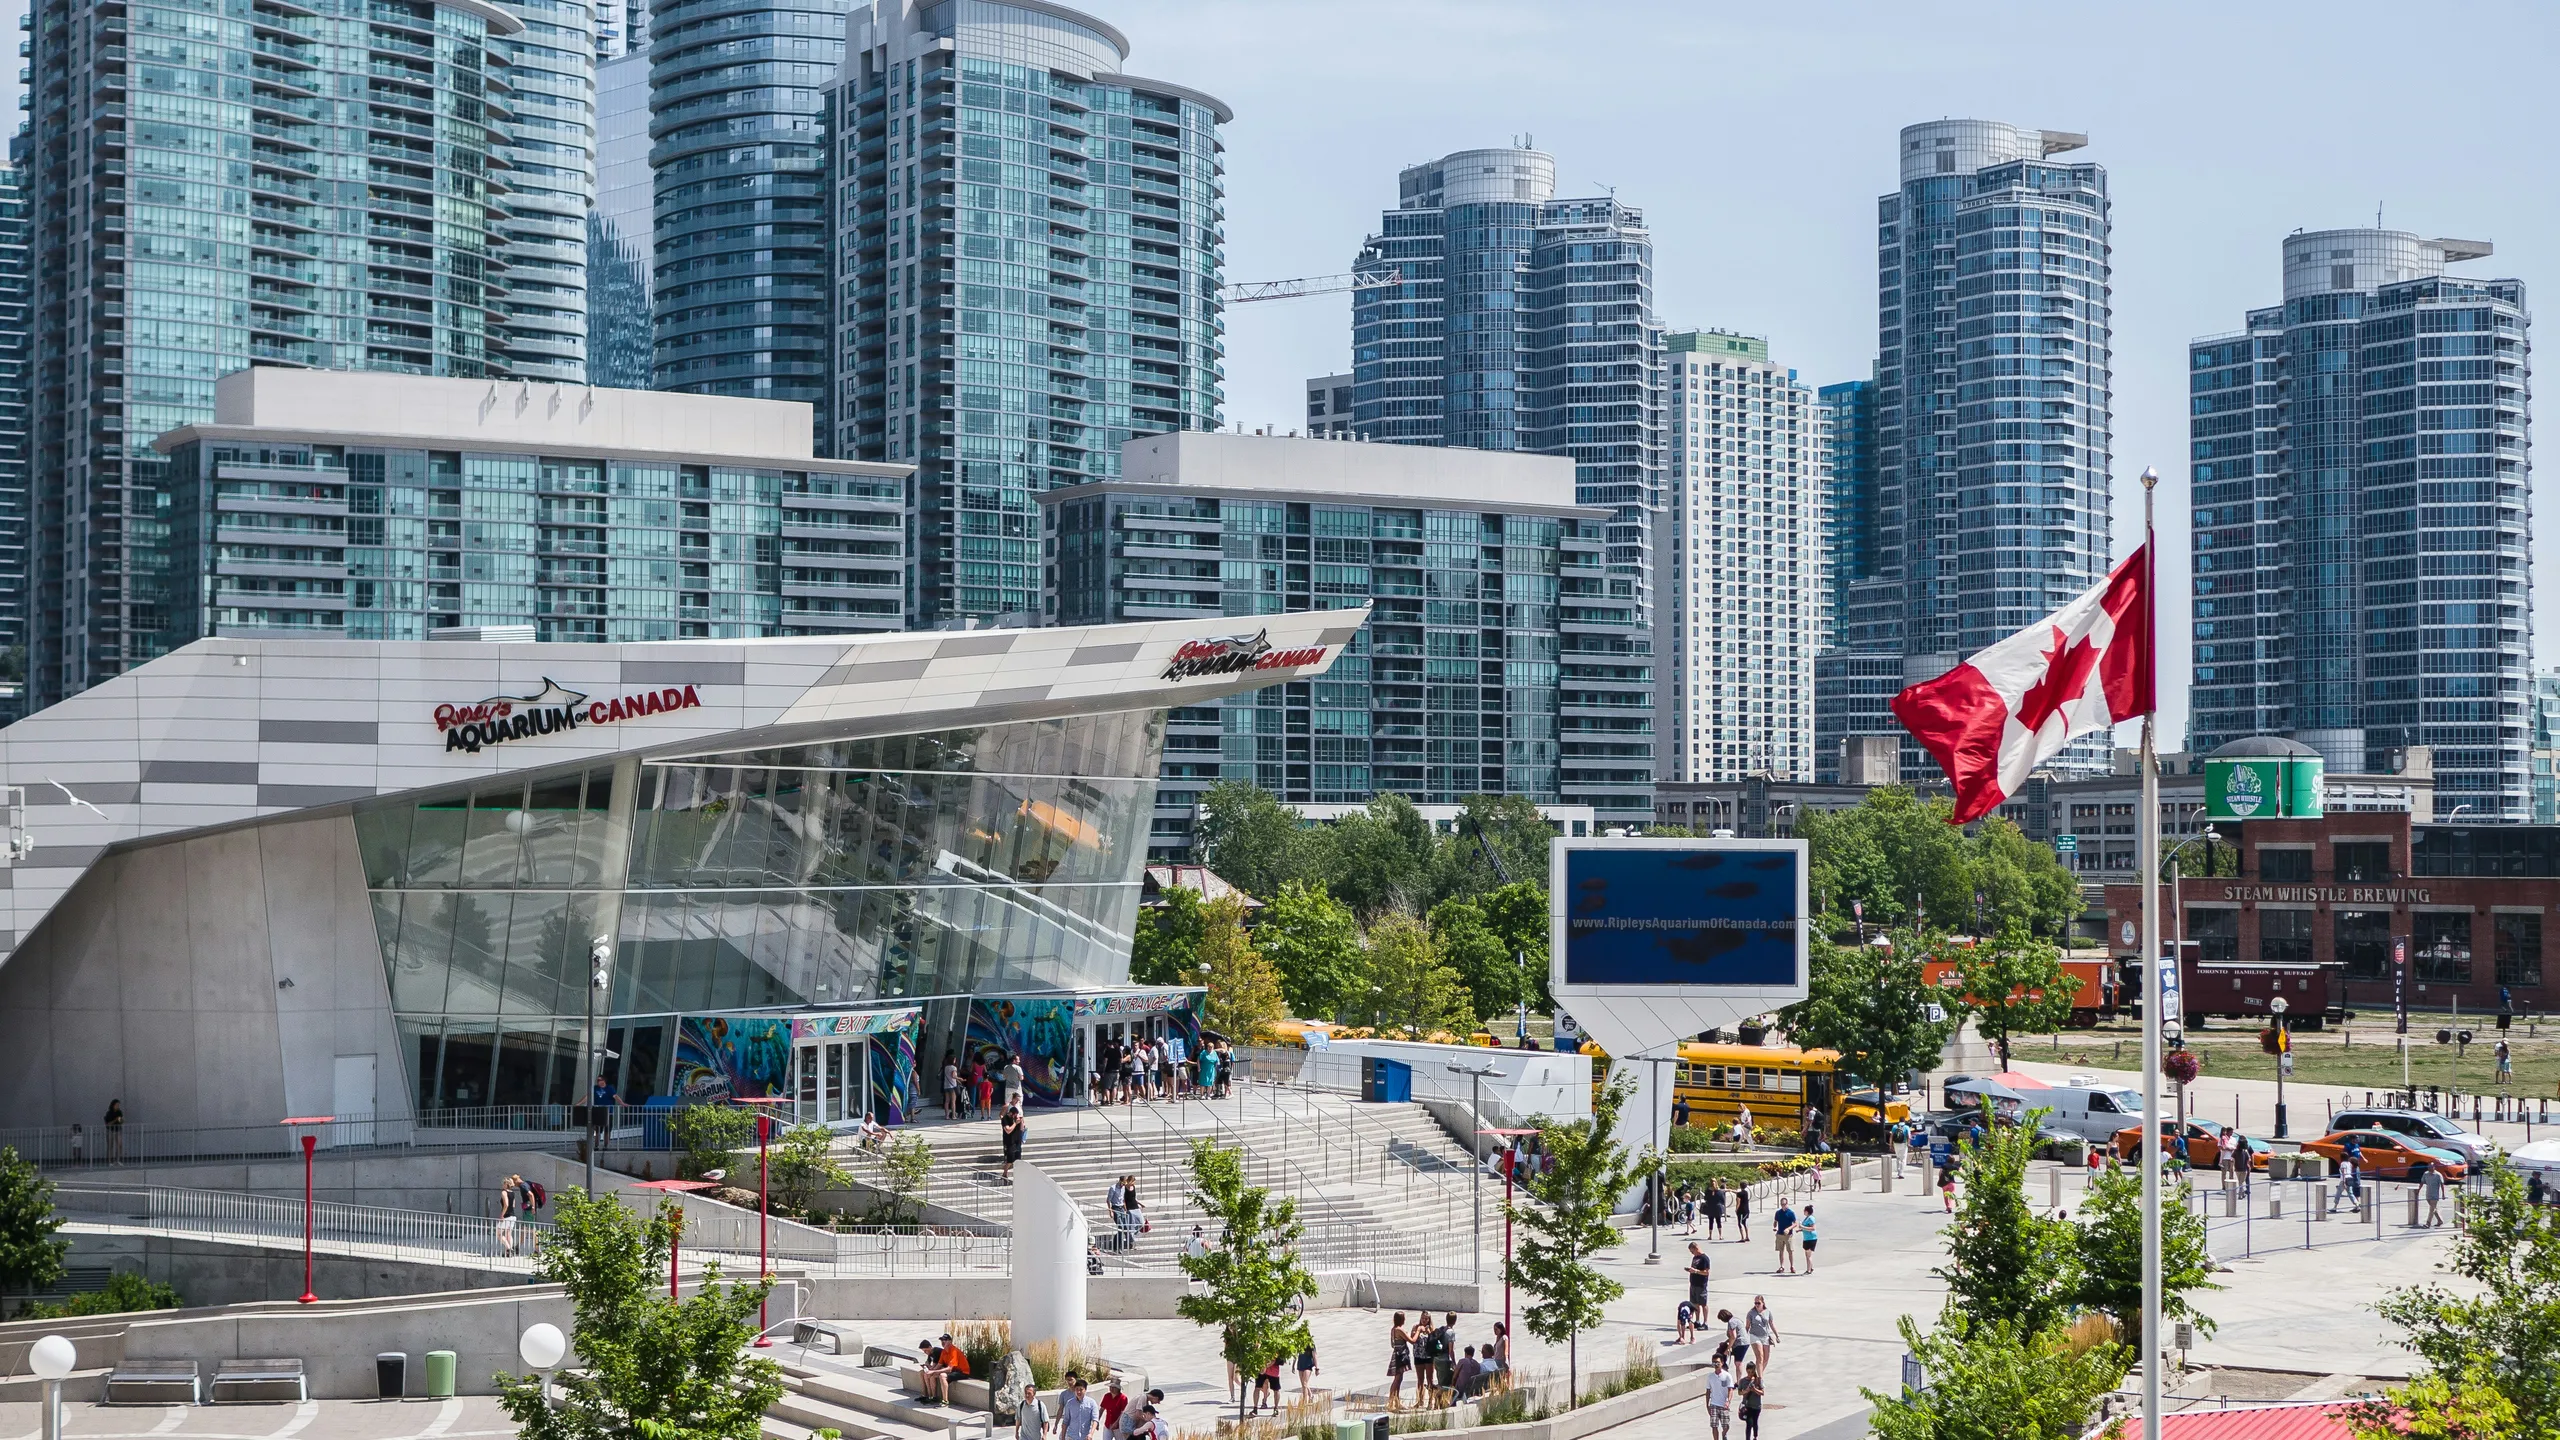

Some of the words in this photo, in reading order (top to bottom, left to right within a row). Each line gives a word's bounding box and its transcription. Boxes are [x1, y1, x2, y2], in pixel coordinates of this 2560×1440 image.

[1255, 648, 1327, 670] CANADA
[446, 706, 577, 753] AQUARIUM
[589, 685, 702, 725] CANADA
[2224, 886, 2274, 901] STEAM
[2277, 887, 2347, 902] WHISTLE
[2353, 888, 2430, 903] BREWING
[1572, 917, 1796, 931] www.RipleysAquariumOfCanada.com
[1106, 995, 1168, 1013] ENTRANCE
[835, 1015, 872, 1033] EXIT
[1753, 1093, 1775, 1101] STOCK
